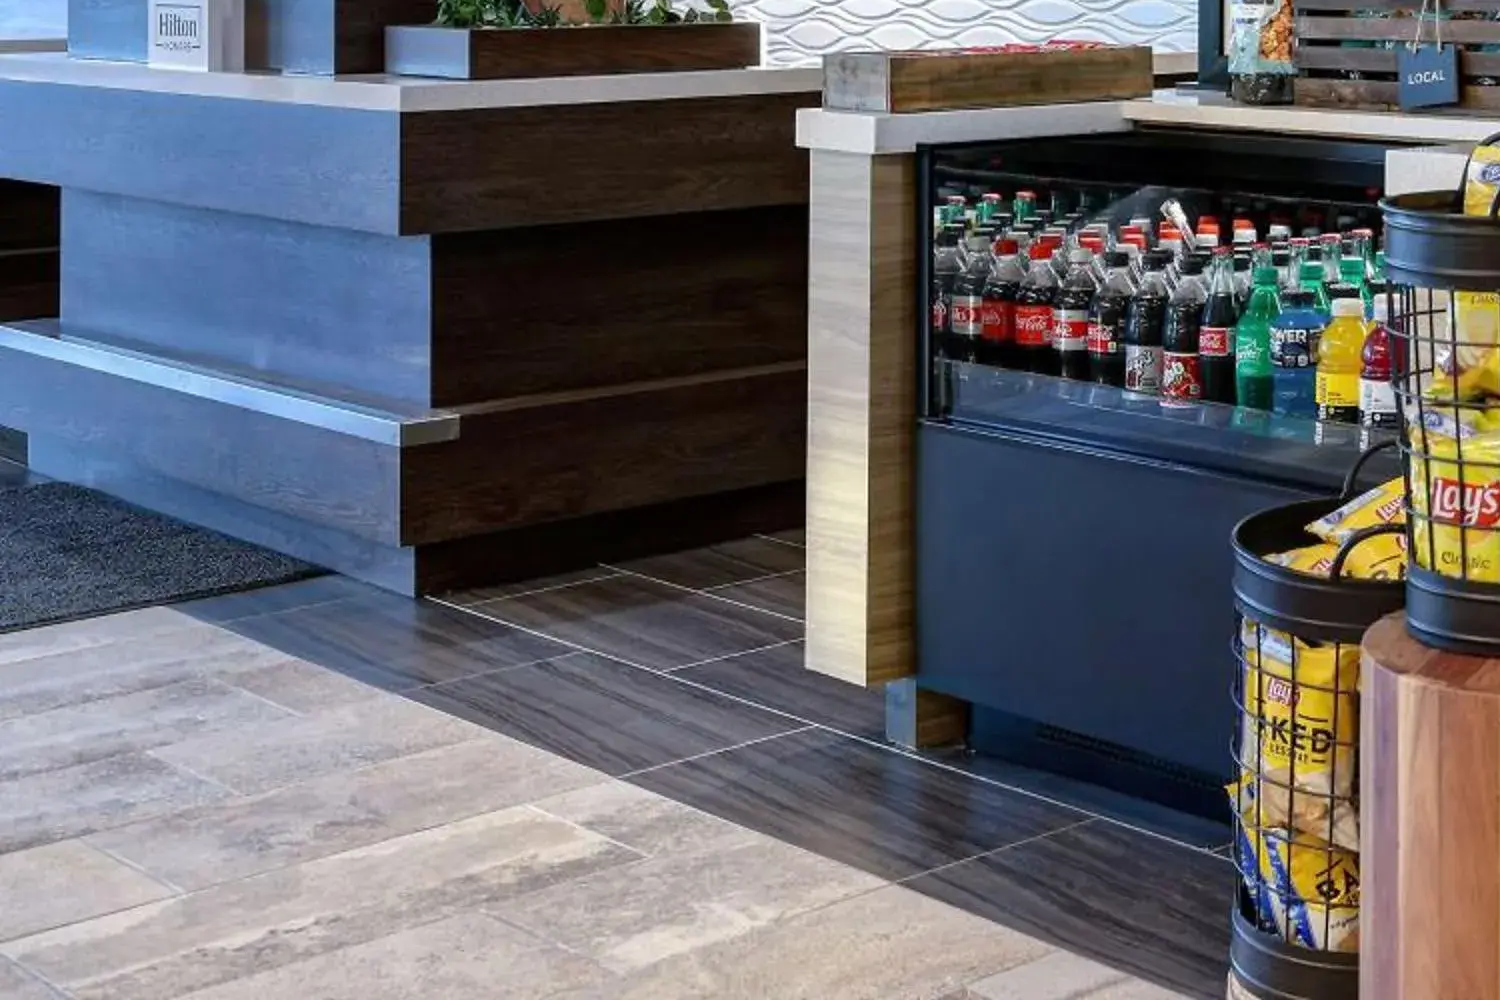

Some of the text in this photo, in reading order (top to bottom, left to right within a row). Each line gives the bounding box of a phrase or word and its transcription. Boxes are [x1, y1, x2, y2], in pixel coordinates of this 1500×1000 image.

[159, 10, 197, 37] Hilton
[1407, 70, 1446, 84] LOCAL
[1432, 479, 1500, 526] Lay's
